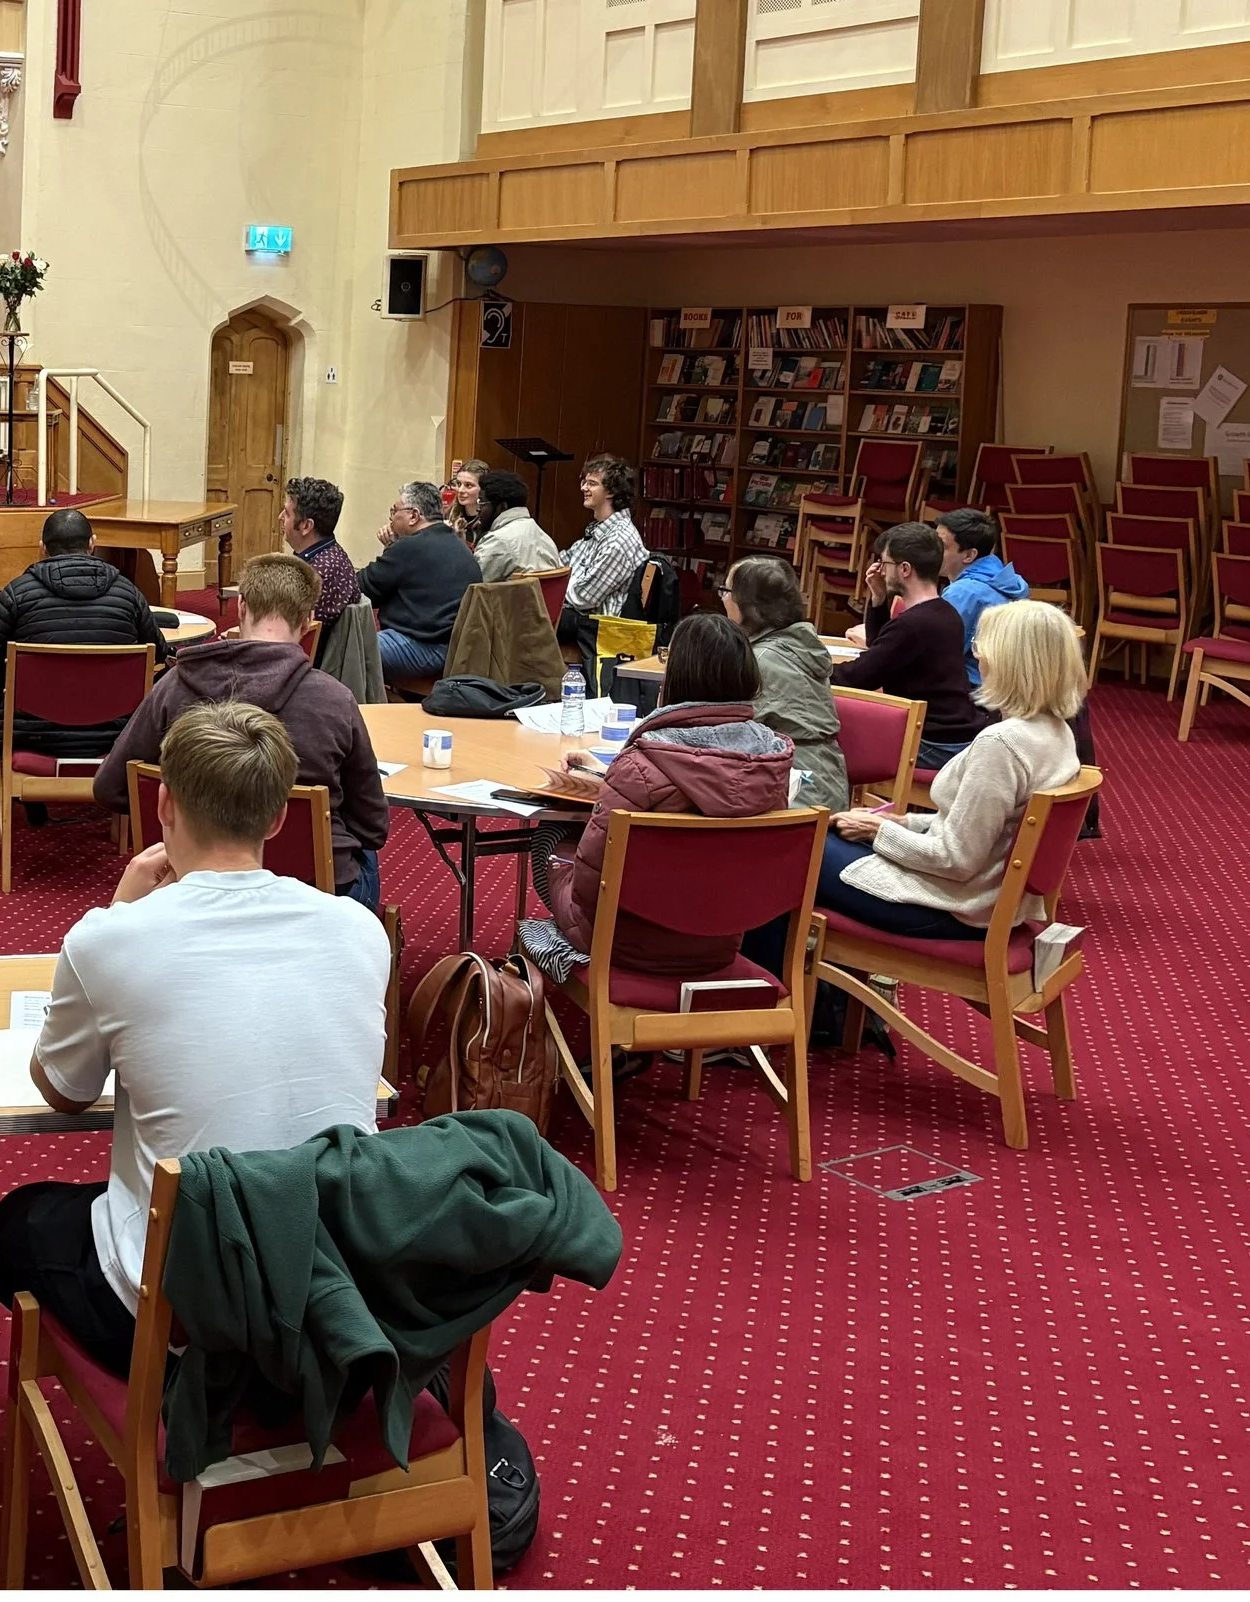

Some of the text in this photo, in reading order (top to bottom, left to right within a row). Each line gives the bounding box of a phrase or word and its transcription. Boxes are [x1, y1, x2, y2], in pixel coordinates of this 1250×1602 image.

[683, 311, 917, 321] BOOKS FOR SALE
[501, 333, 507, 343] T
